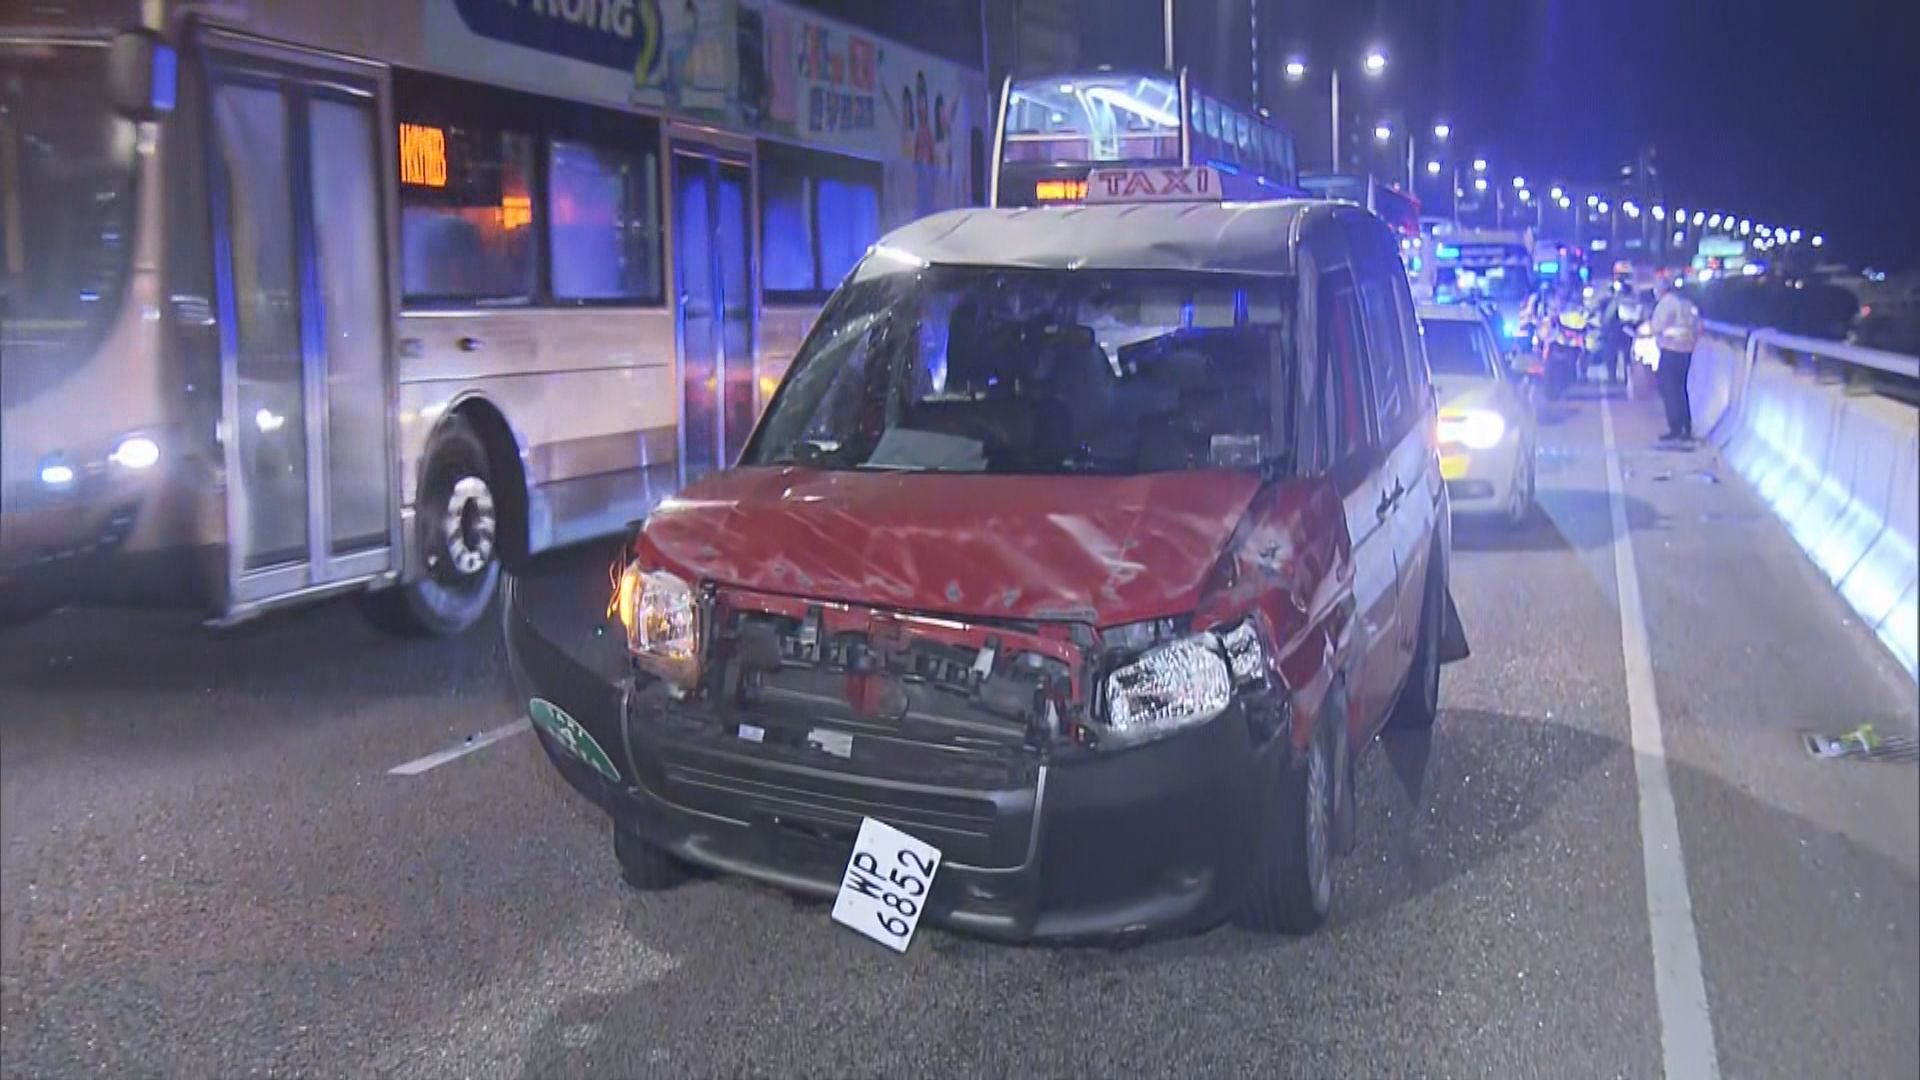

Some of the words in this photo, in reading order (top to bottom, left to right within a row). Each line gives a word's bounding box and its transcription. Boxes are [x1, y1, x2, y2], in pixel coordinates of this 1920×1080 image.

[1100, 169, 1208, 196] TAXI
[845, 851, 887, 900] WP
[876, 848, 935, 937] 6852
